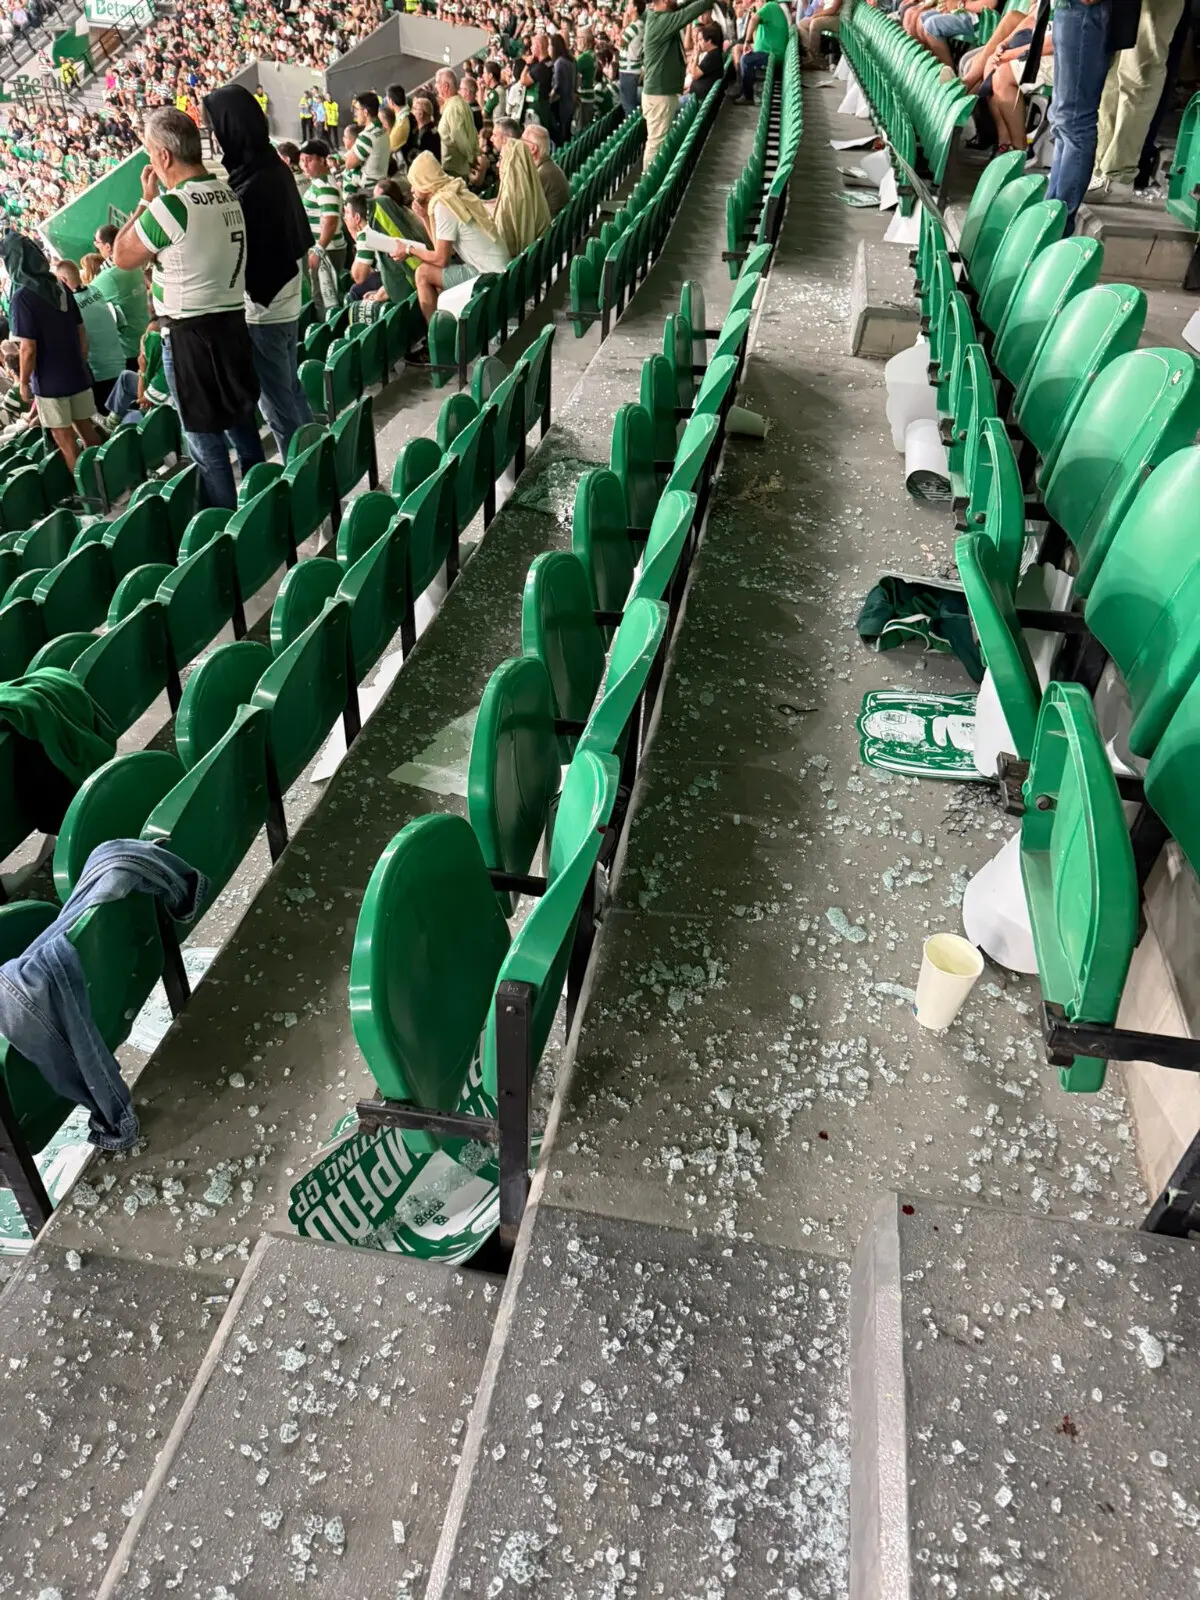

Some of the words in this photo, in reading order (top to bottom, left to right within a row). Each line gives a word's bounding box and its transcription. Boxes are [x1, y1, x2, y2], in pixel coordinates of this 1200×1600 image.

[191, 190, 229, 205] SUPER
[229, 230, 245, 289] 7
[294, 1179, 322, 1219] CP
